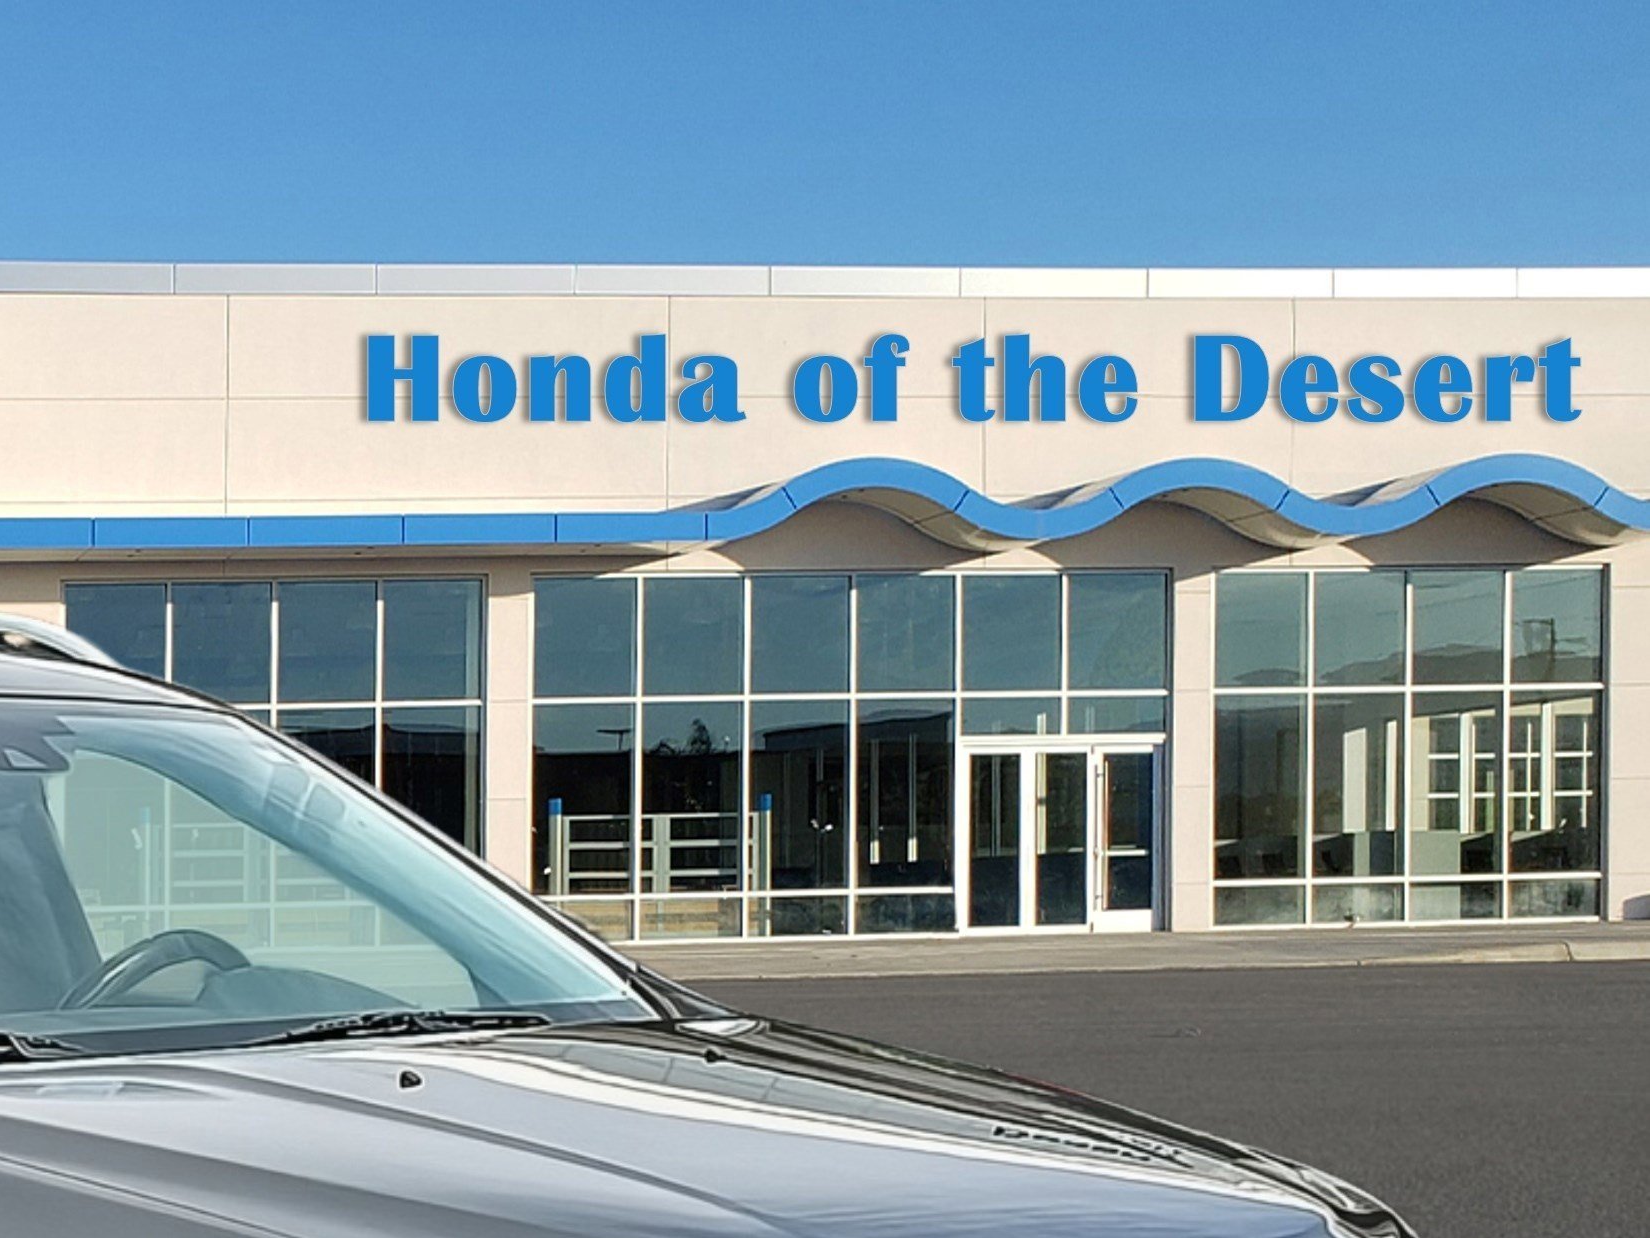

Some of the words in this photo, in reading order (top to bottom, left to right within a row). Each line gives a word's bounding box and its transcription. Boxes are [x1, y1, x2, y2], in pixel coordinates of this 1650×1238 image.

[366, 333, 747, 423] Honda
[793, 333, 910, 423] of
[951, 333, 1139, 423] the
[1193, 335, 1583, 423] Desert
